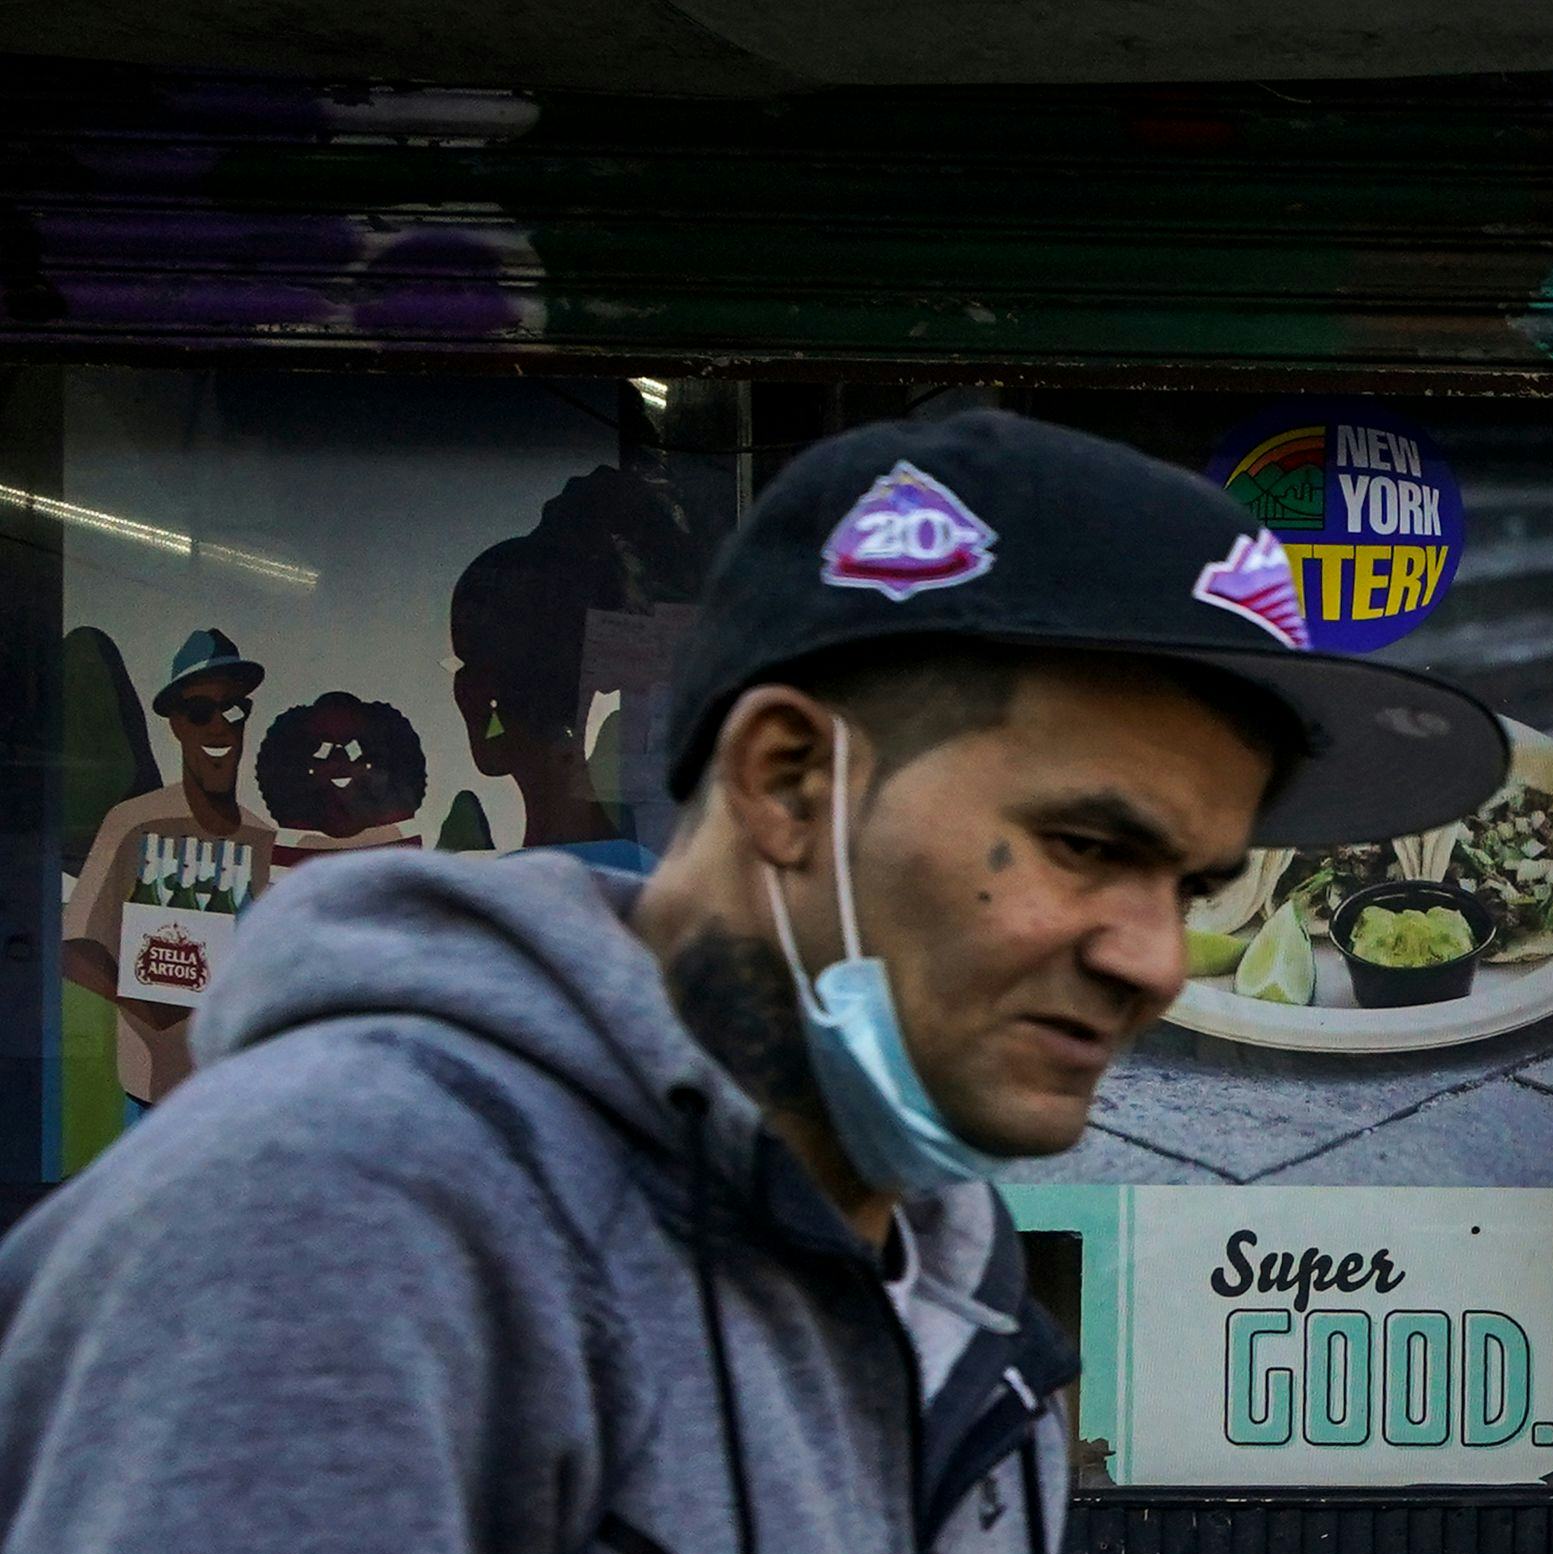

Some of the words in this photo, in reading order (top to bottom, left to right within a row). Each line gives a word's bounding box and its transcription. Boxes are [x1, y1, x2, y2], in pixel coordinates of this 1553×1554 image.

[1337, 424, 1421, 478] NEW
[1338, 473, 1442, 536] YORK
[1281, 543, 1449, 621] TTERY
[148, 962, 198, 980] ARTOIS
[149, 946, 198, 965] STELLA
[1210, 1229, 1406, 1313] Super
